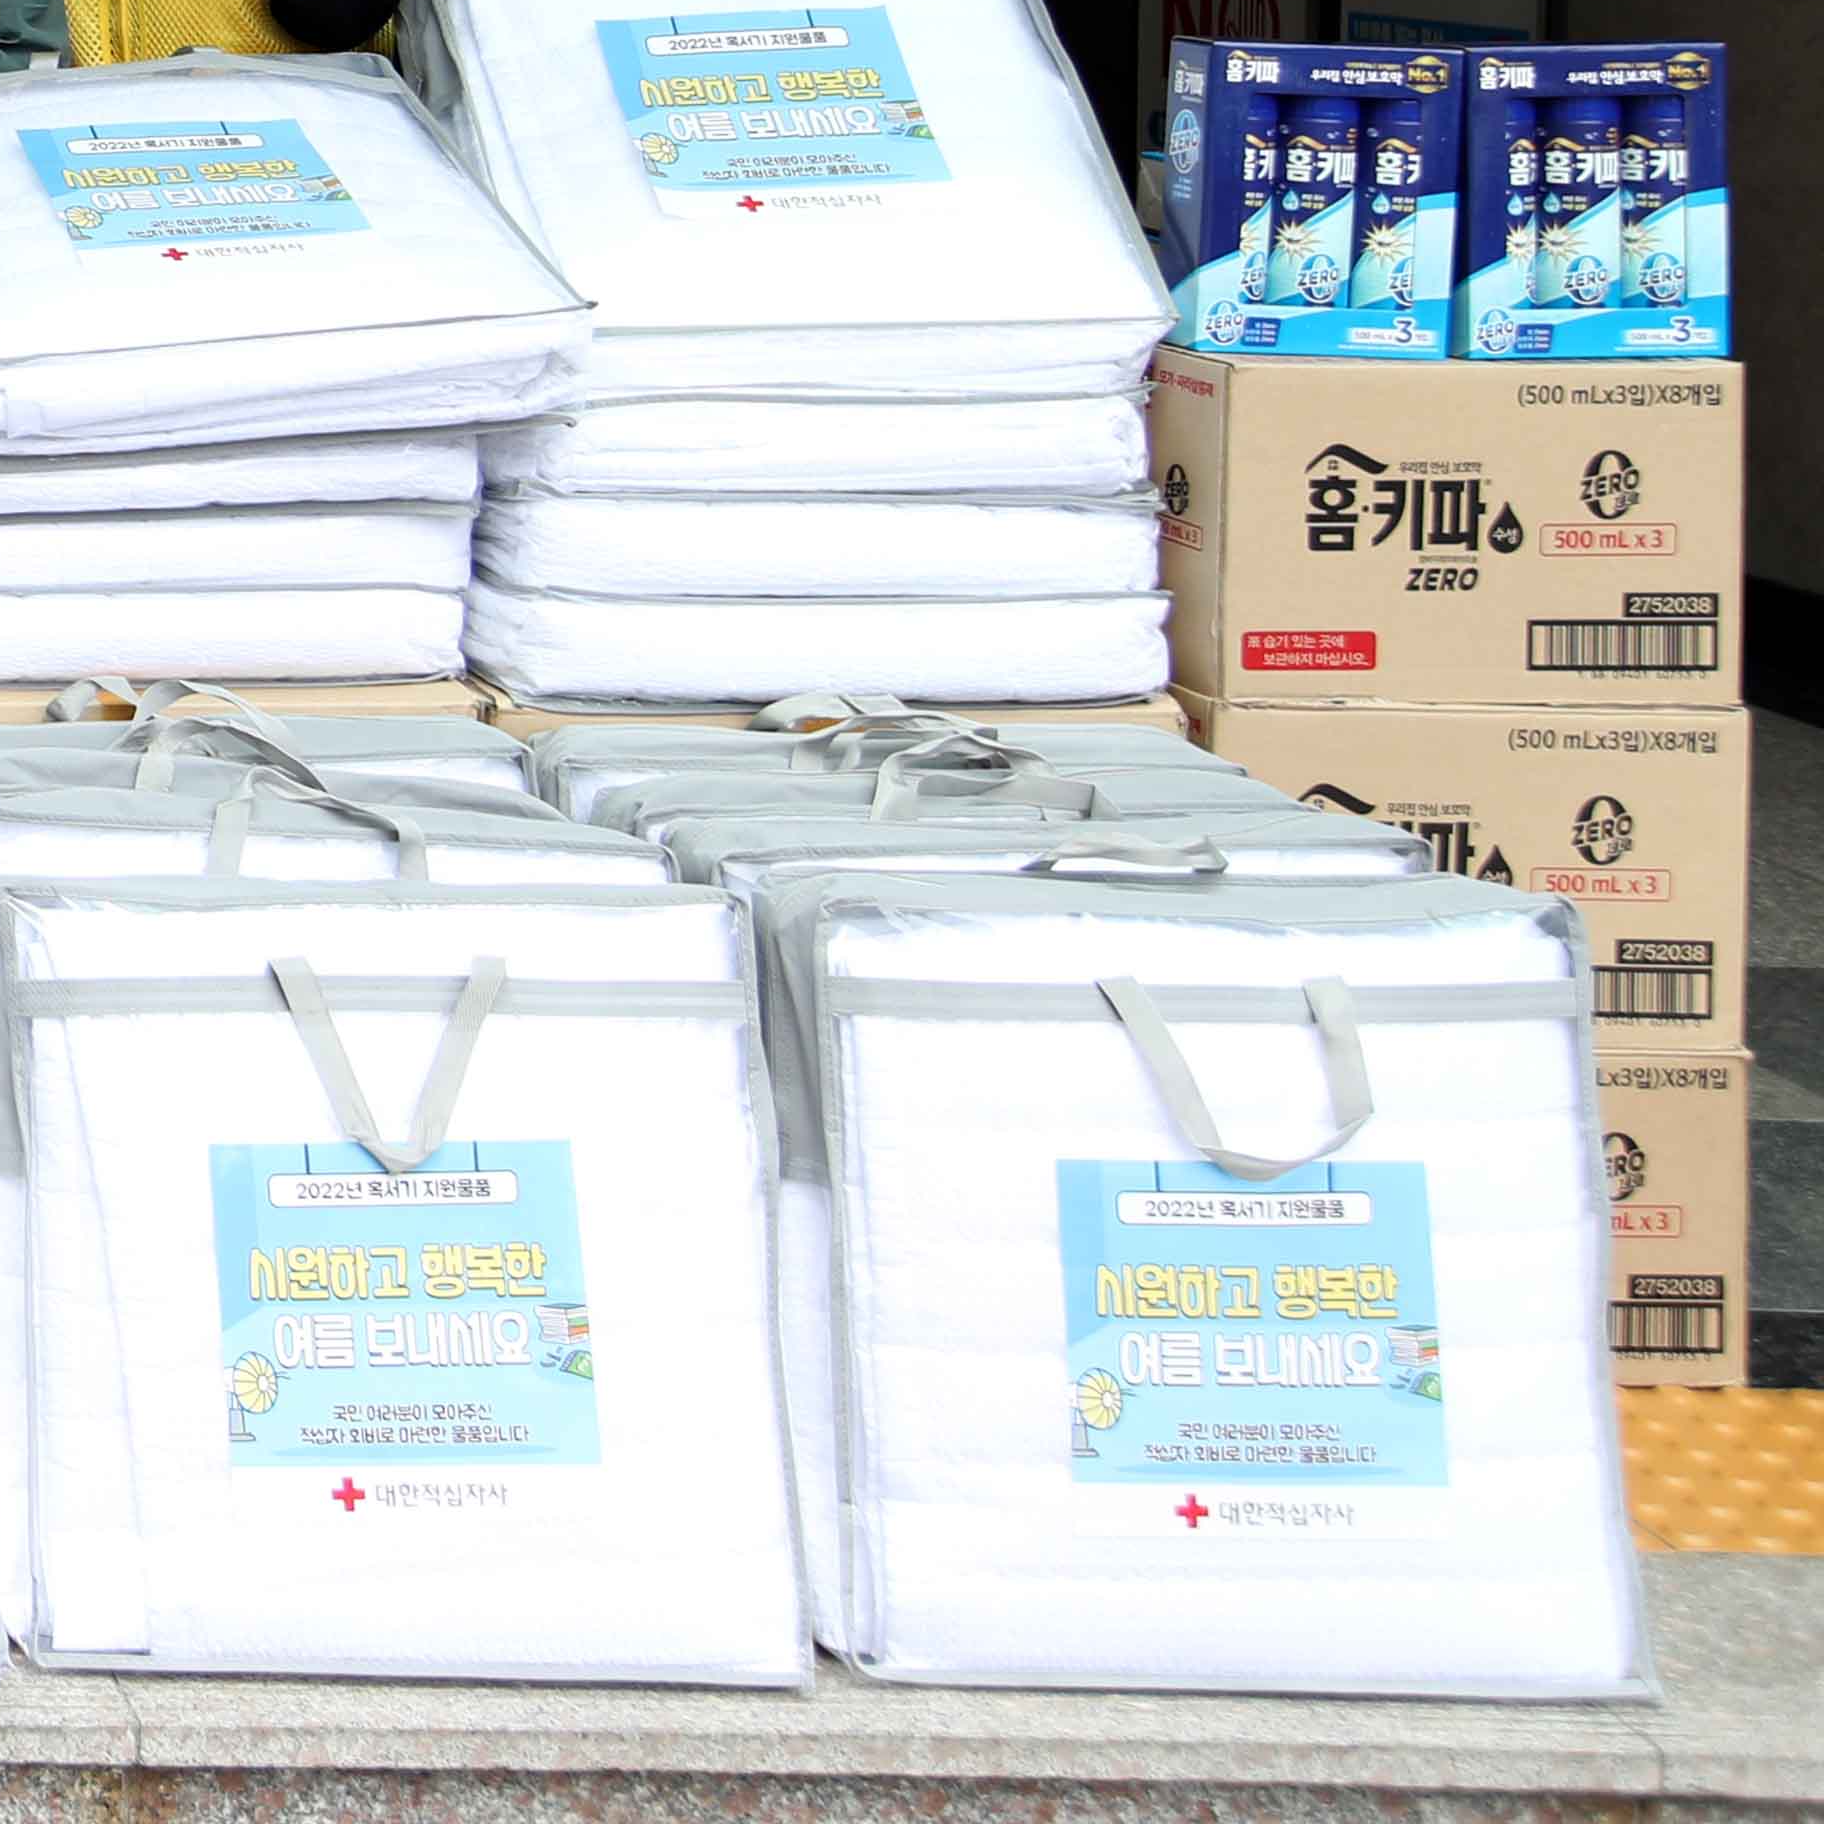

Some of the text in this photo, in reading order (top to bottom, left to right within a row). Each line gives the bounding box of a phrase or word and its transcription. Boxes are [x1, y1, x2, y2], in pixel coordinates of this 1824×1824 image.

[639, 68, 886, 107] 시원하고 행복한
[666, 106, 882, 143] 여름 보내세요
[1205, 315, 1242, 331] ZERO
[1518, 385, 1563, 407] (500
[1554, 530, 1629, 548] 500 mL
[1406, 568, 1479, 591] ZERO
[1630, 596, 1712, 614] 2752038
[1621, 942, 1707, 961] 2752038
[296, 1181, 363, 1201] 2022년
[249, 1242, 548, 1301] 시원하고 행복한
[1095, 1264, 1400, 1319] 시원하고 행복한
[1633, 1278, 1718, 1298] 2752038
[274, 1310, 532, 1369] 여름 보내세요
[1119, 1331, 1383, 1388] 여름 보내세요
